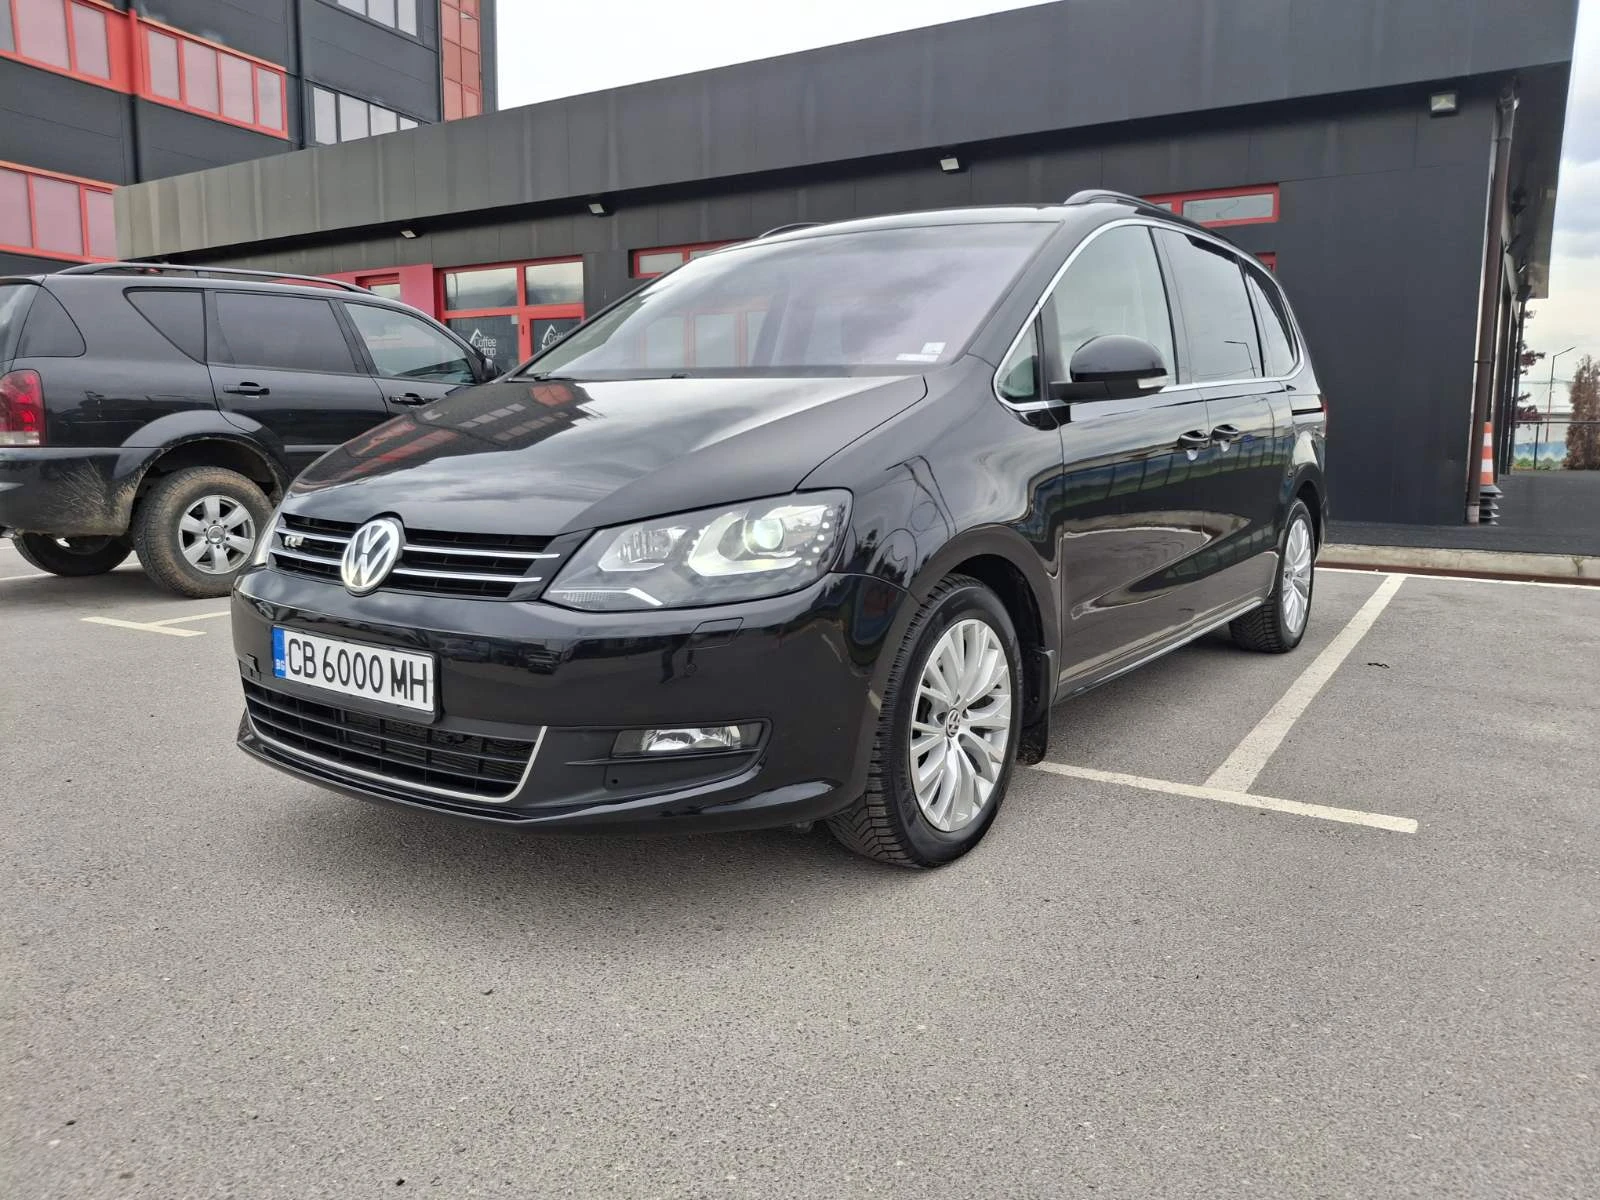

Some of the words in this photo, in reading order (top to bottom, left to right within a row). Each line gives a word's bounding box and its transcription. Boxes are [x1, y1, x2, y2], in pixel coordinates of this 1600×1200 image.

[473, 335, 497, 347] Coffee
[288, 638, 317, 679] CB
[322, 645, 384, 694] 6000
[390, 657, 427, 704] MH
